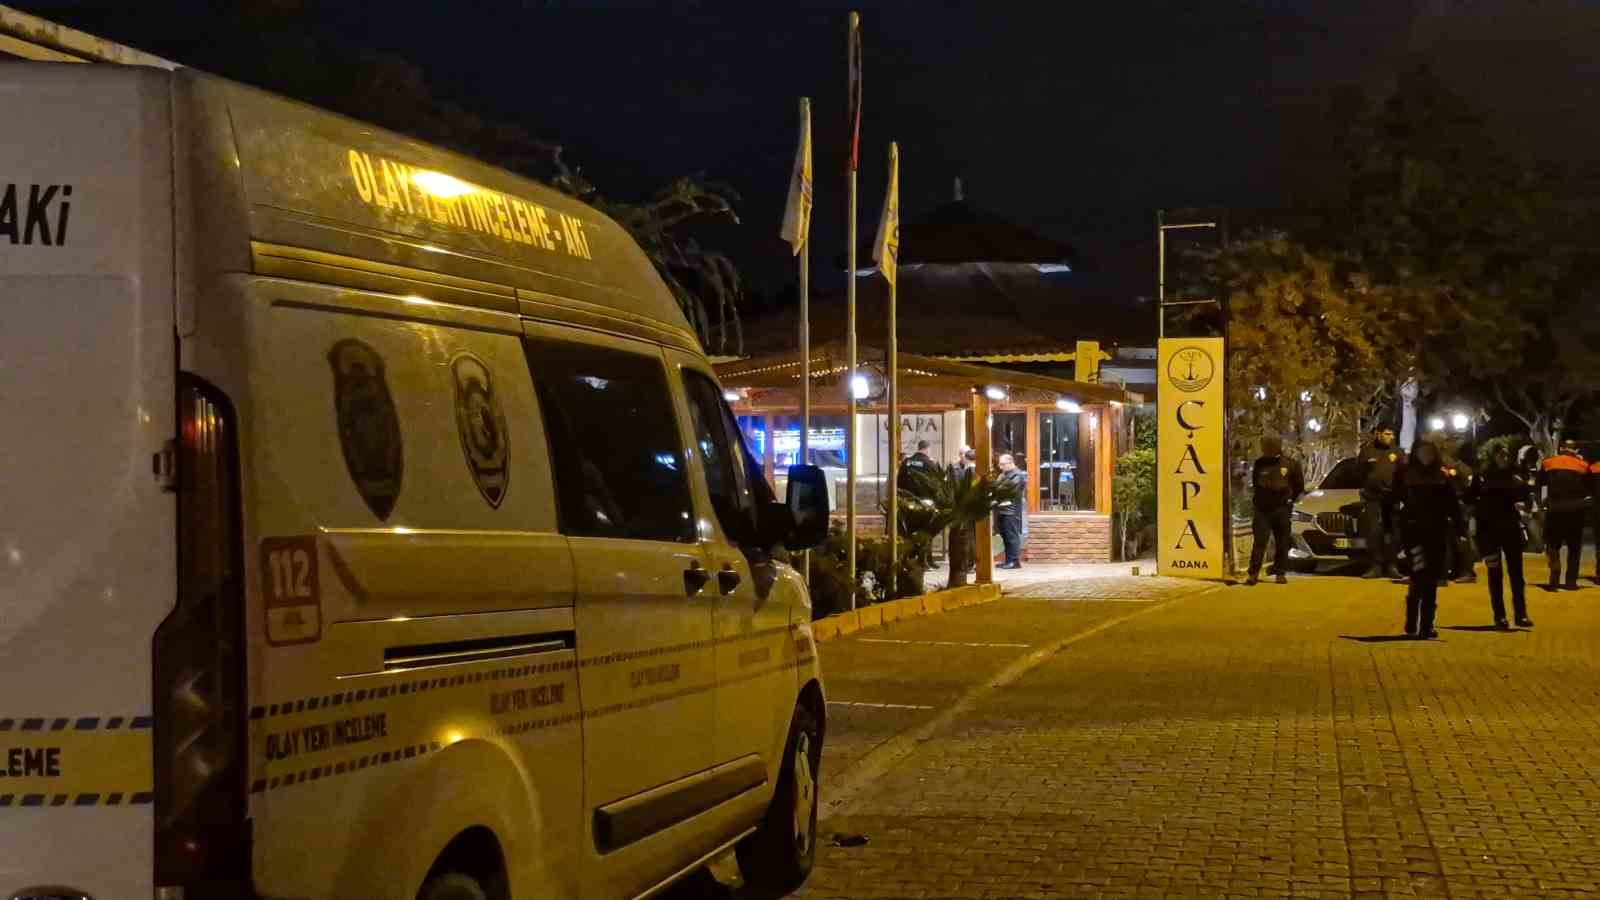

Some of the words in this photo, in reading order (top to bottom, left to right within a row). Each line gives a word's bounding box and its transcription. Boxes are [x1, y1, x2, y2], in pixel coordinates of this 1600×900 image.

[349, 150, 414, 214] OLAY
[269, 550, 312, 599] 112
[1171, 560, 1208, 569] ADANA
[265, 730, 301, 760] OLAY
